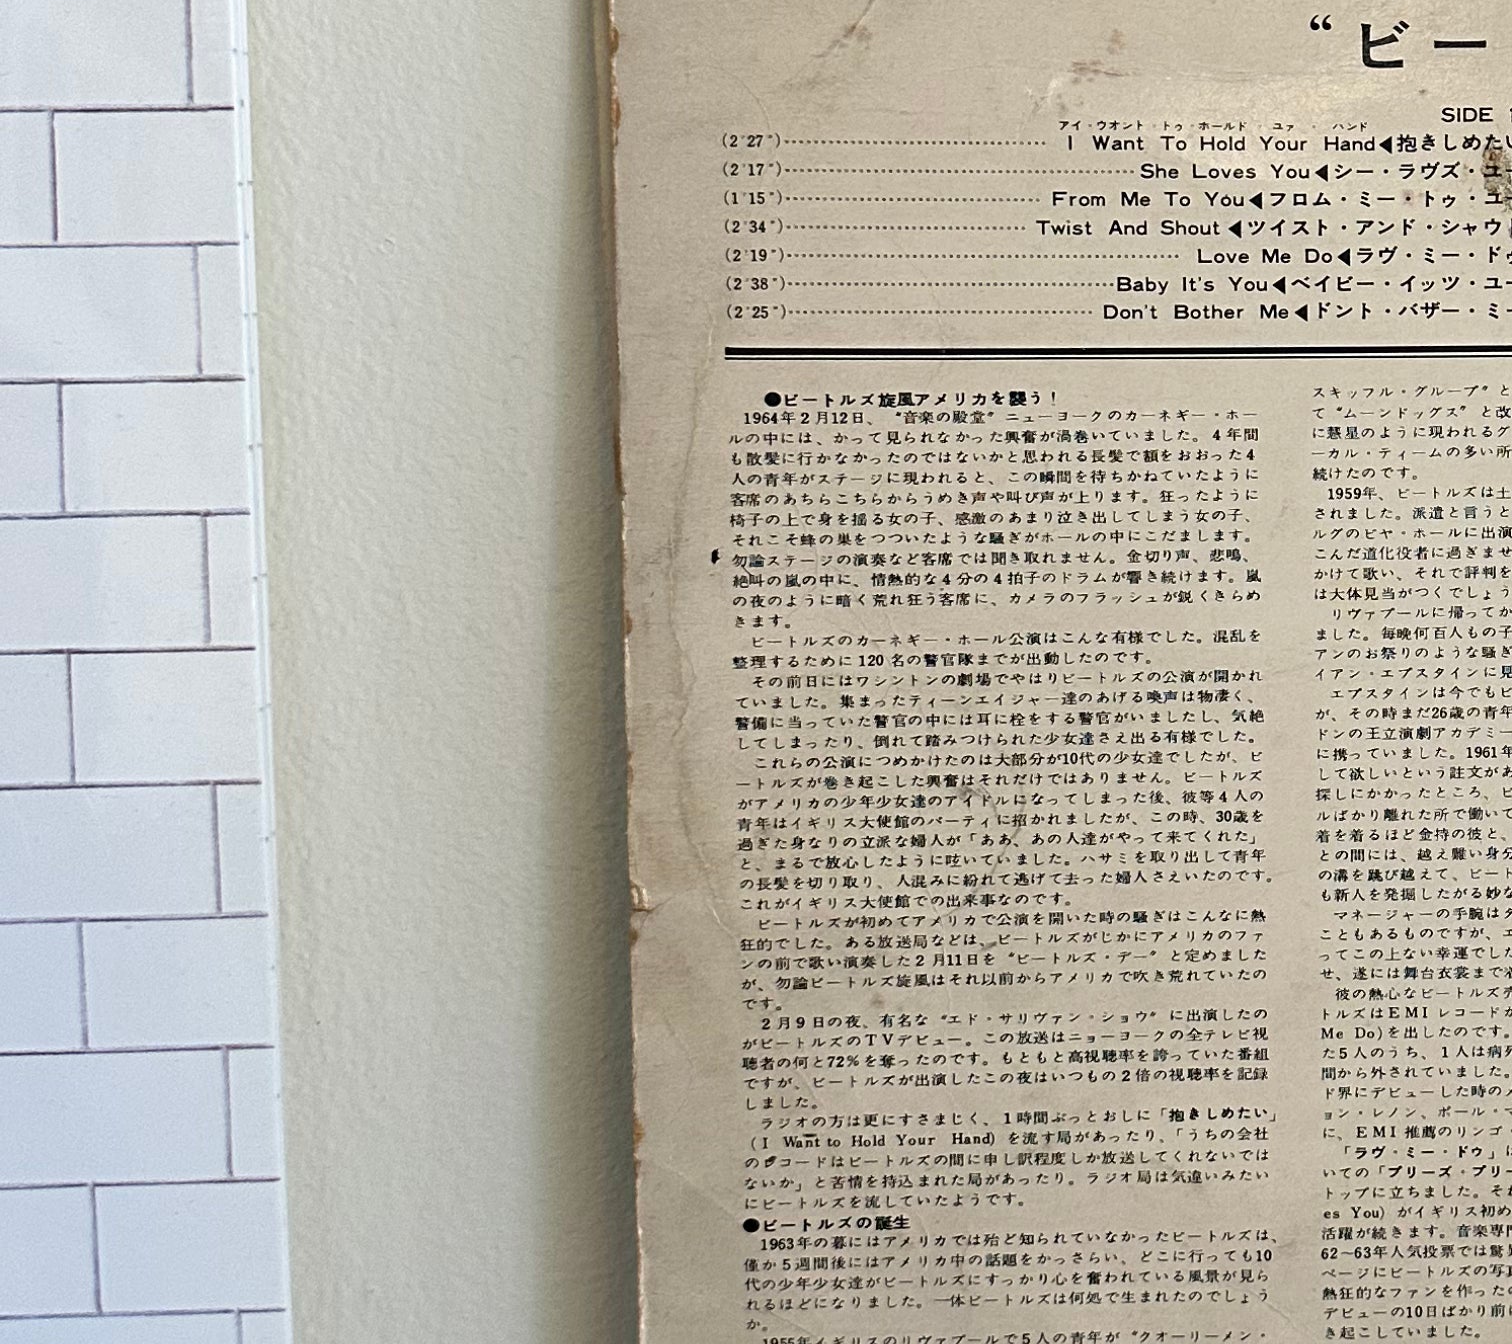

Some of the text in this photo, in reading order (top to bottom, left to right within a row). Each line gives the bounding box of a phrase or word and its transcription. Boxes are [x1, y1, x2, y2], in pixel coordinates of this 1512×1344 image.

[1441, 107, 1494, 123] SIDE
[1067, 135, 1074, 151] I
[1092, 136, 1145, 151] Want
[1160, 136, 1188, 151] To
[1200, 136, 1246, 151] Hold
[1259, 136, 1308, 151] Your
[1323, 136, 1376, 152] Hand
[1140, 163, 1179, 180] She
[1192, 163, 1257, 180] Loves
[1270, 163, 1310, 180] You
[1052, 191, 1106, 207] From
[1120, 191, 1151, 207] Me
[1164, 191, 1191, 207] To
[1204, 191, 1245, 207] You
[1036, 220, 1093, 236] Twist
[1108, 220, 1148, 236] And
[1160, 220, 1221, 236] Shout
[1197, 248, 1250, 264] Love
[1262, 248, 1292, 264] Me
[1304, 248, 1333, 264] Do
[1116, 276, 1169, 296] Baby
[1182, 276, 1215, 292] It's
[1228, 276, 1268, 292] You
[1103, 303, 1158, 320] Don't
[1174, 304, 1245, 320] Bother
[1260, 304, 1289, 320] Me
[733, 614, 793, 630] きます。
